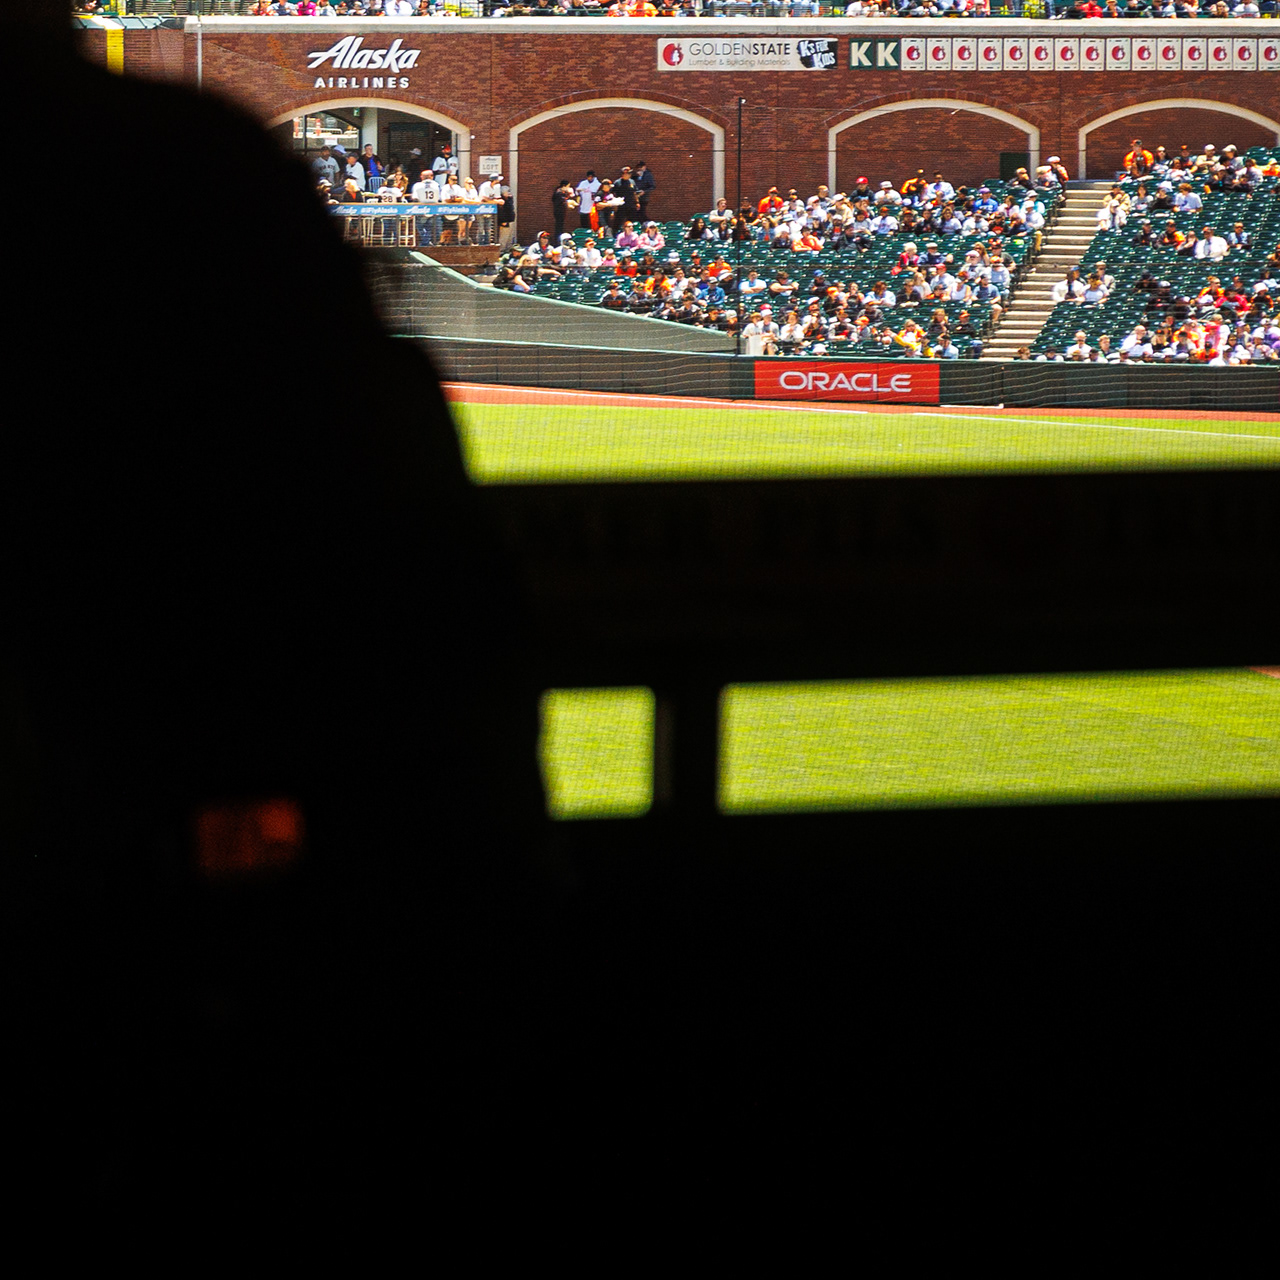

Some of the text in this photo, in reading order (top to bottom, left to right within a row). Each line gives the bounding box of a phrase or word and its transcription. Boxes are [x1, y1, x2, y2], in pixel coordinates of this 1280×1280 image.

[307, 36, 421, 73] Alaska
[314, 77, 410, 89] AIRLINES
[779, 370, 913, 393] ORACLE
